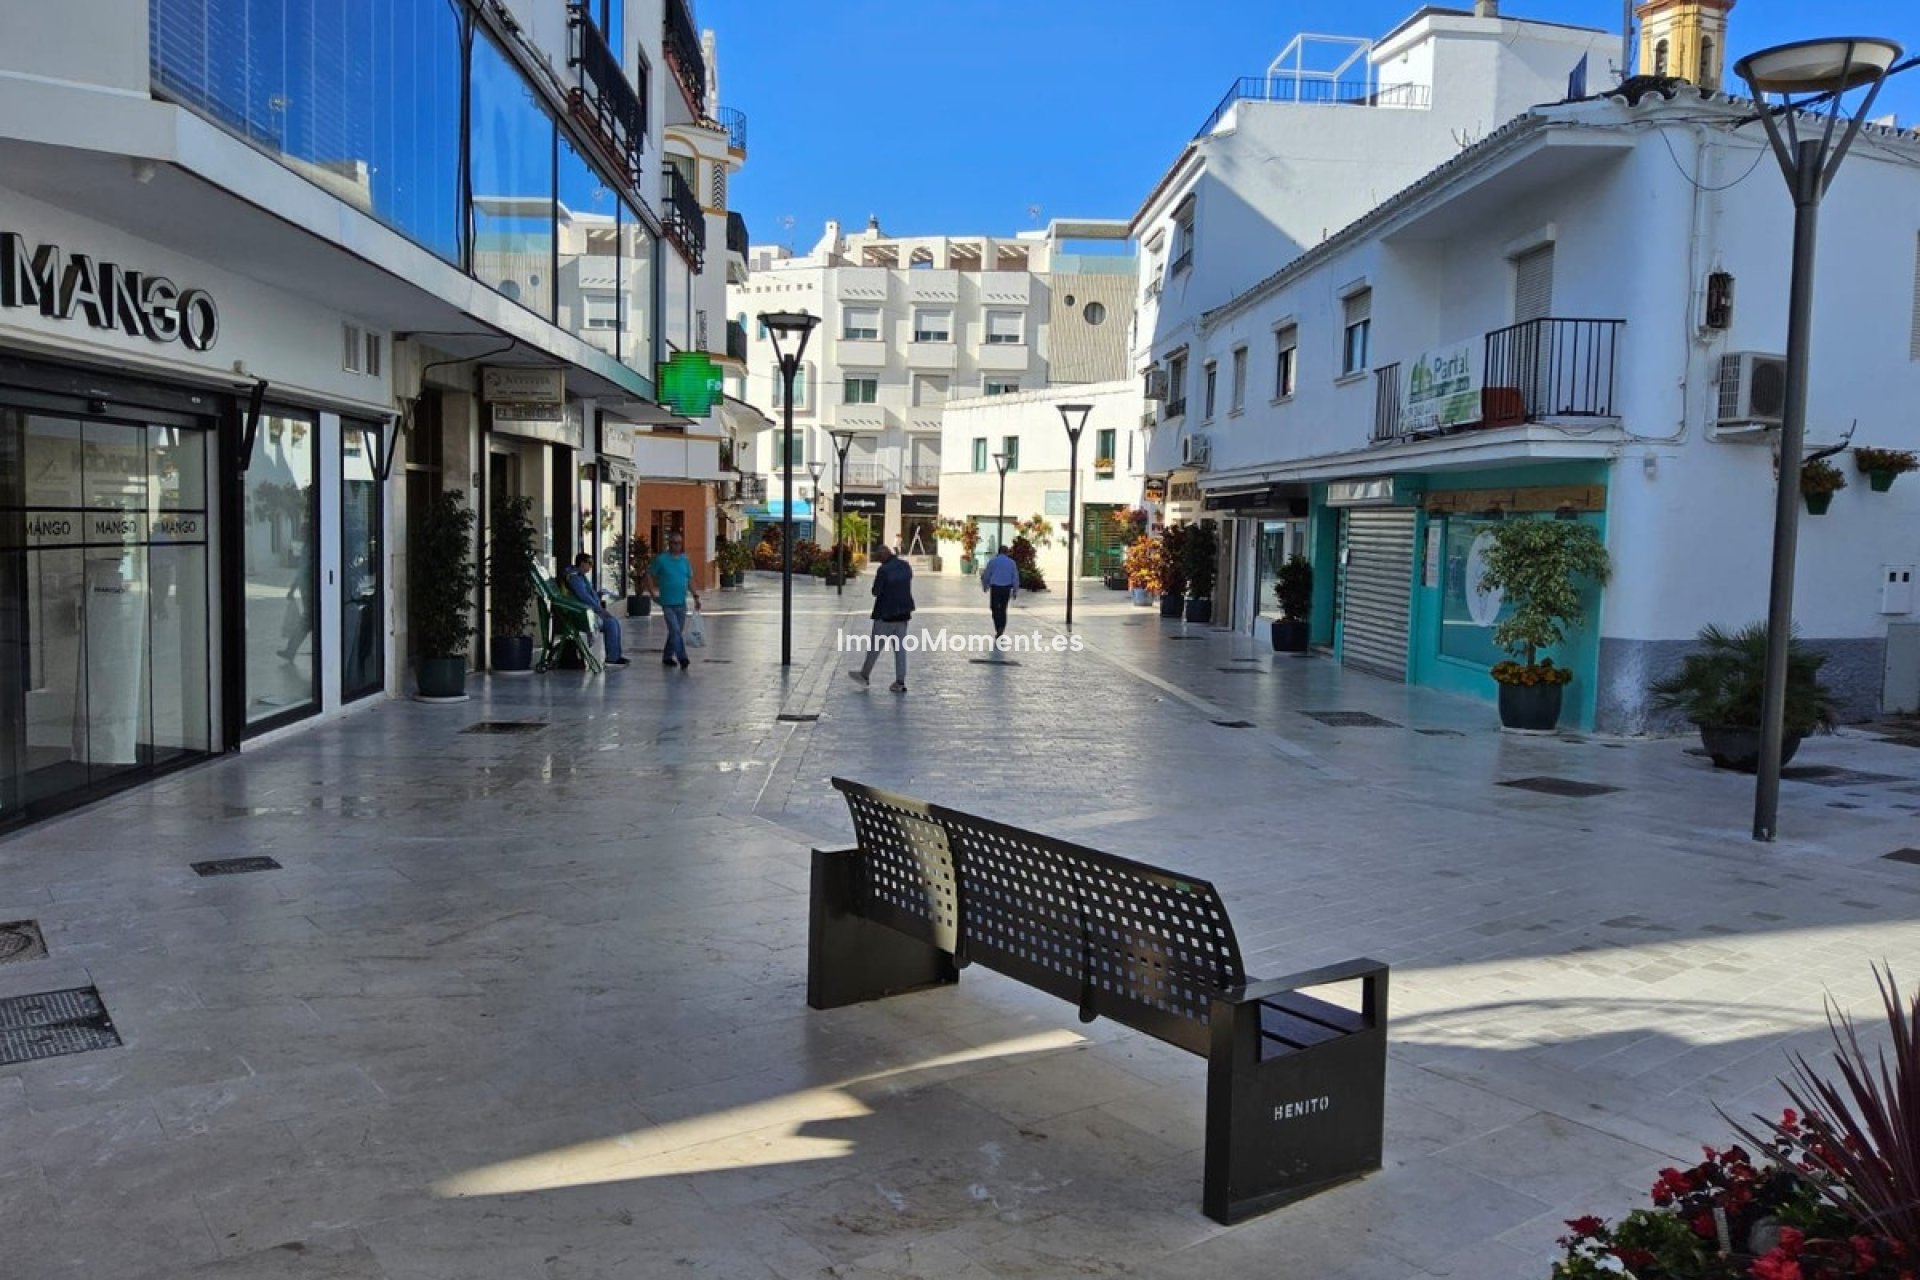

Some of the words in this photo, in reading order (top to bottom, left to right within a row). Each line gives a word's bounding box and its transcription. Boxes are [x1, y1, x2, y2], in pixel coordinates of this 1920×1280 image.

[0, 232, 219, 351] MANGO
[95, 520, 137, 535] MANGO
[161, 520, 196, 534] MANGO
